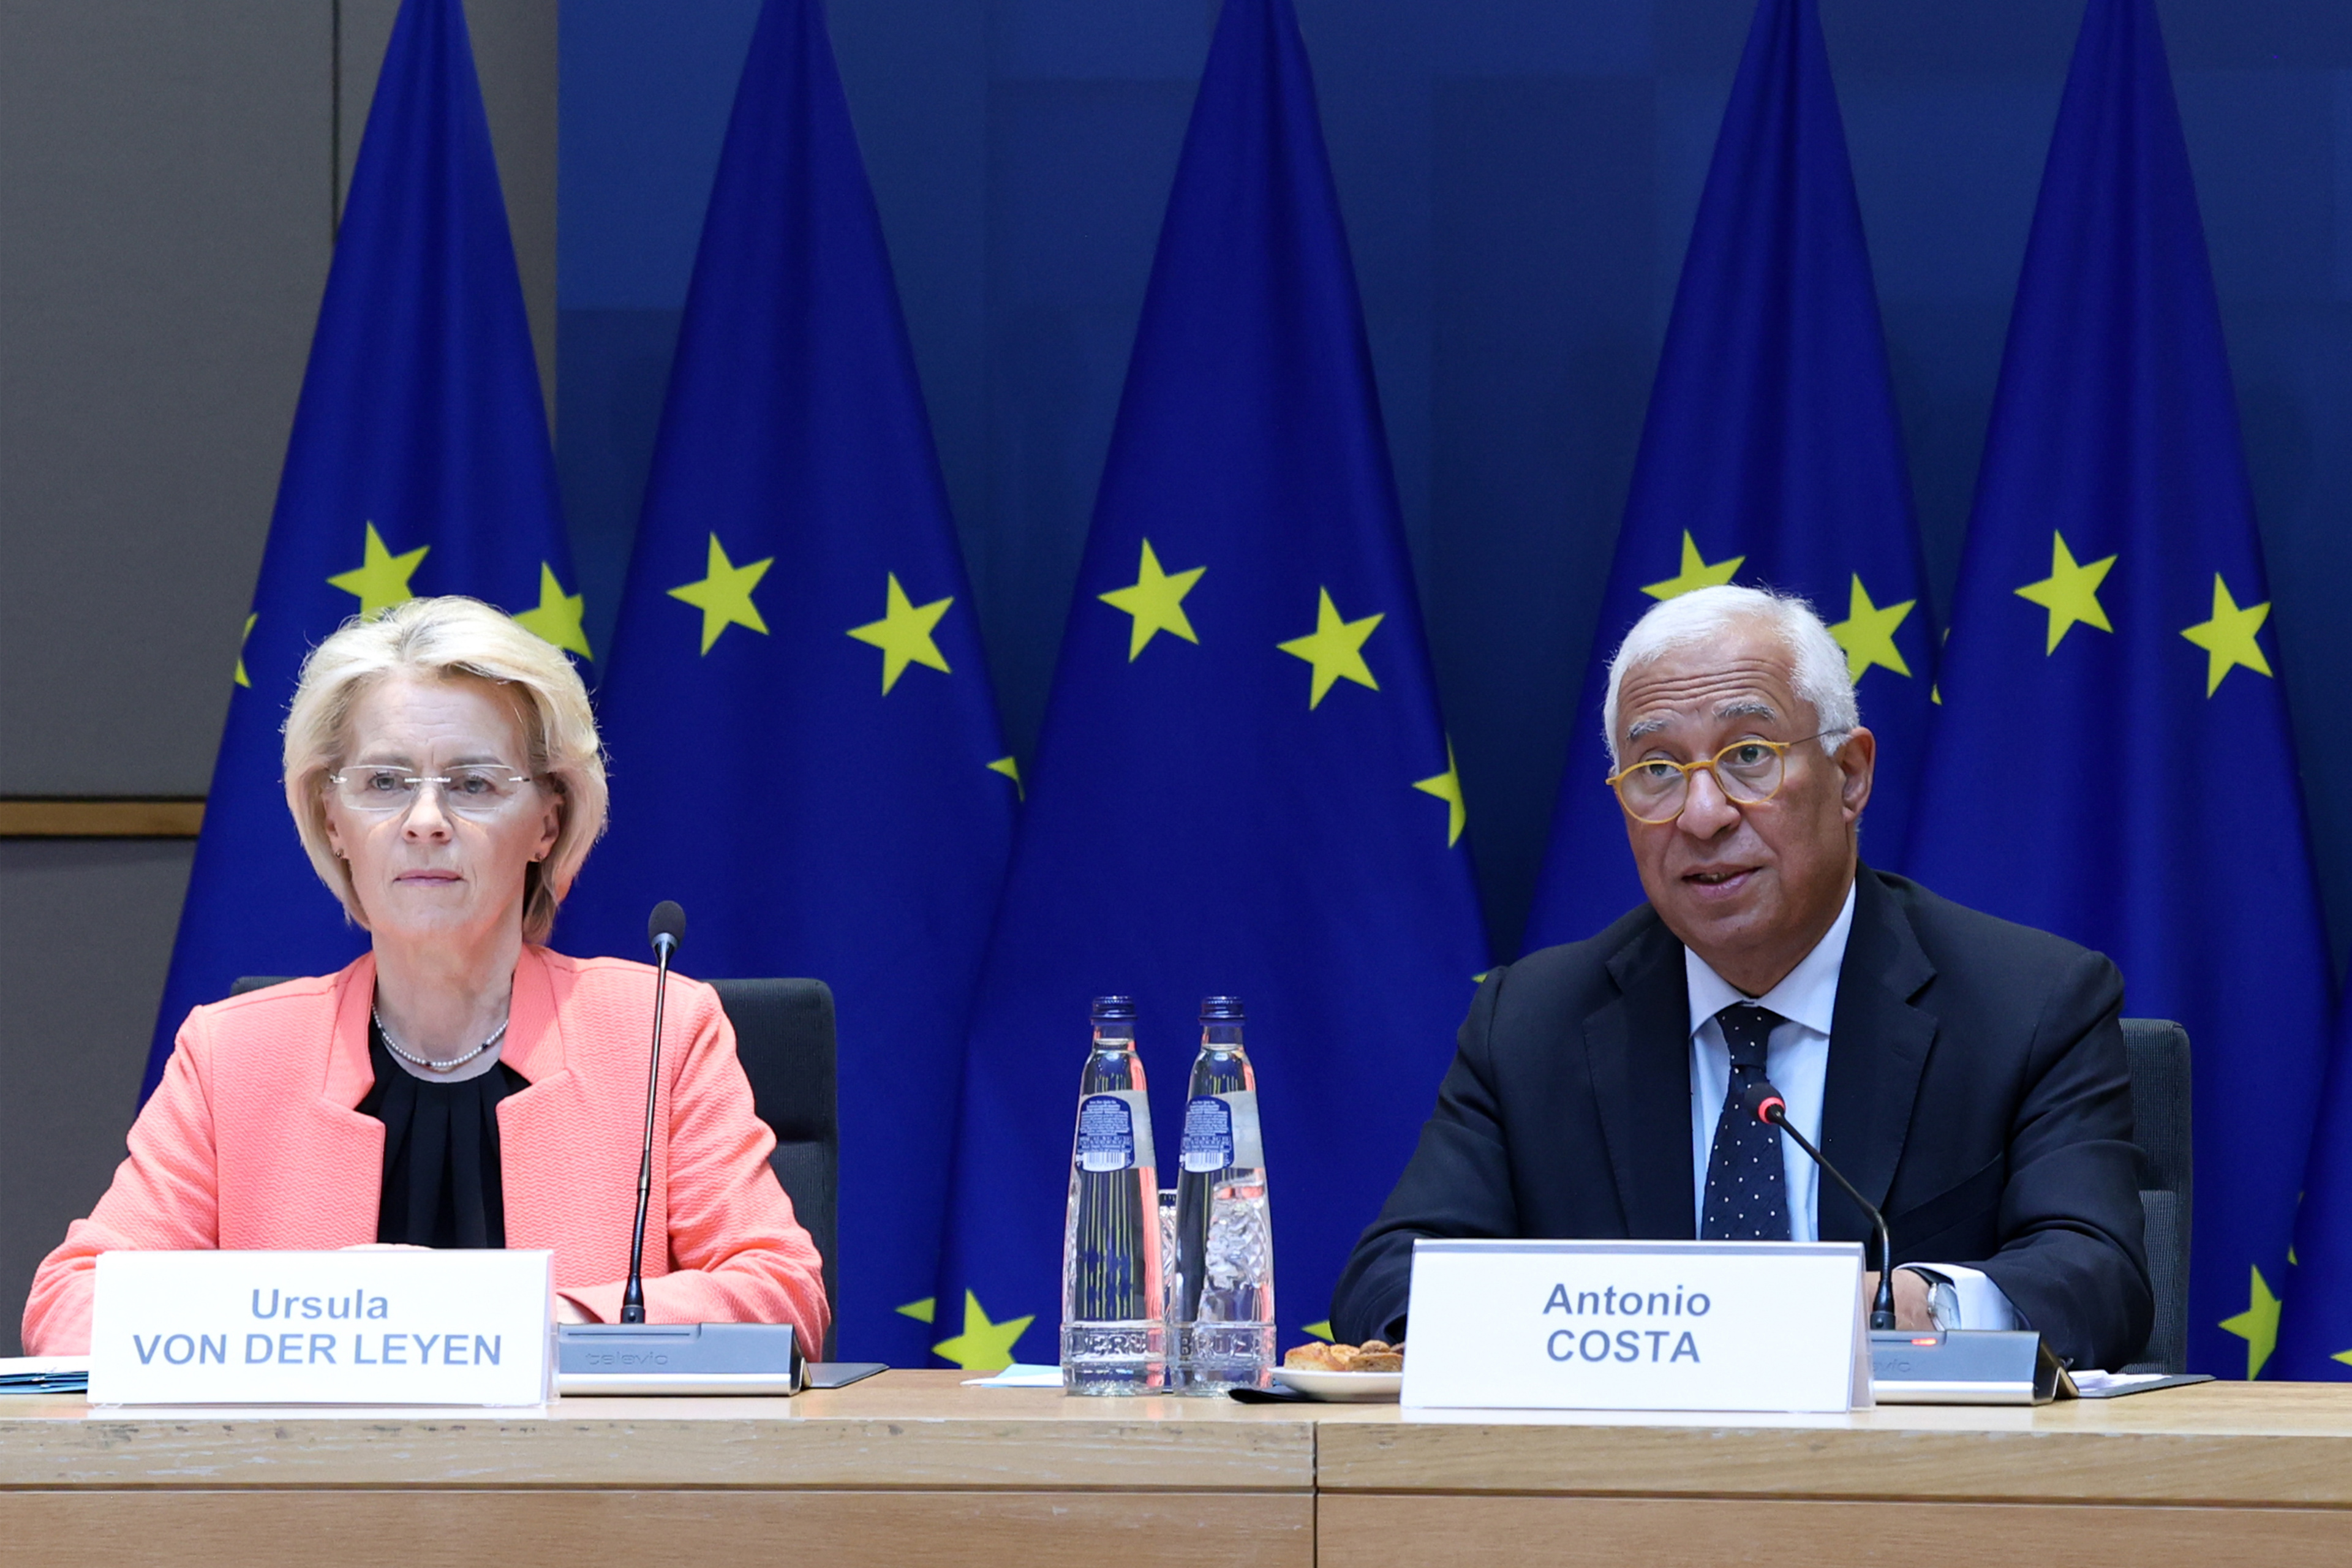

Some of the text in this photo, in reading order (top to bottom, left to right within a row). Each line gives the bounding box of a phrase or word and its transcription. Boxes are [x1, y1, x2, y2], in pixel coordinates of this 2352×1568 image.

[252, 1289, 388, 1319] Ursula
[1543, 1283, 1711, 1316] Antonio
[133, 1334, 501, 1365] VON DER LEYEN
[1547, 1329, 1700, 1363] COSTA
